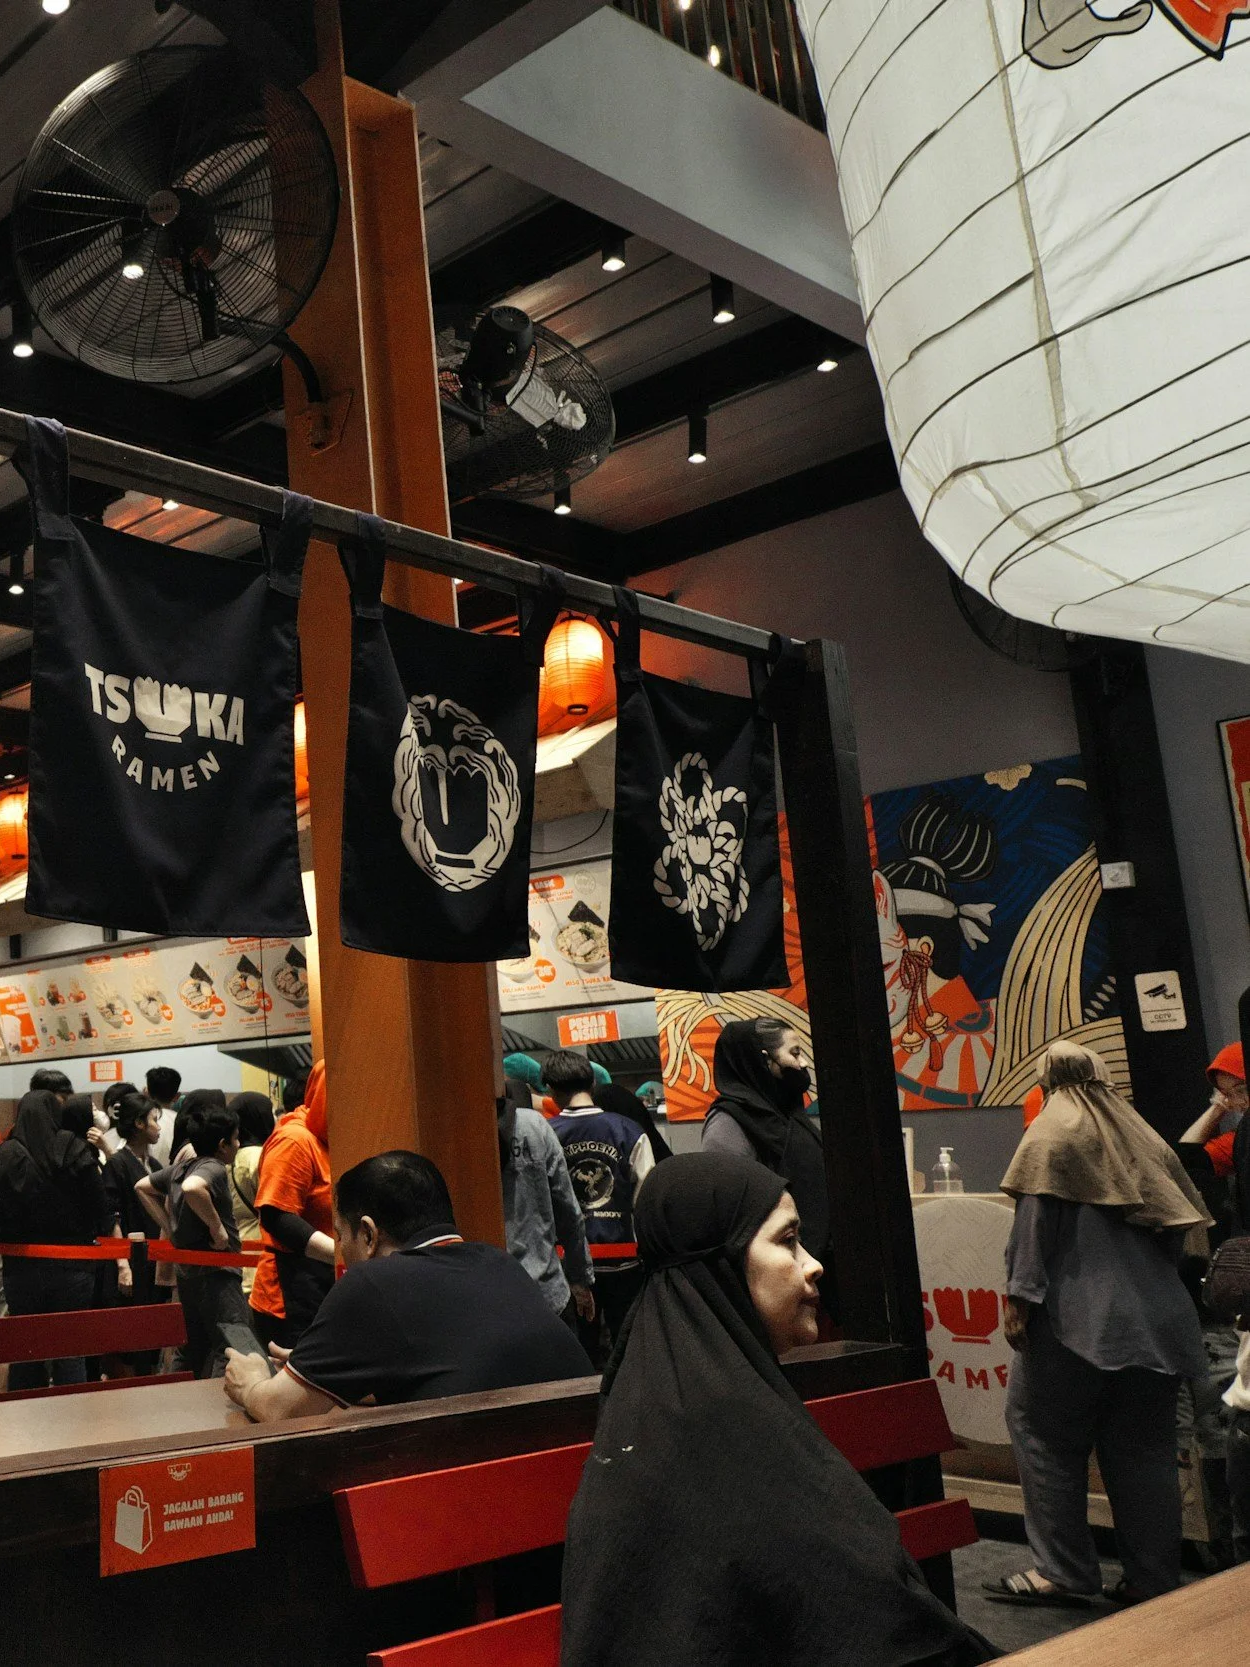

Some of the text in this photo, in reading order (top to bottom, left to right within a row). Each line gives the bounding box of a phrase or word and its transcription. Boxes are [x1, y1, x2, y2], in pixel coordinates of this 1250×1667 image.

[84, 663, 246, 746] TSUKA
[111, 734, 221, 792] RAMEN
[568, 1014, 607, 1031] PESAN
[570, 1028, 608, 1043] DISINI
[928, 1350, 1009, 1391] AME
[163, 1491, 244, 1515] JAGALAH BARANG
[163, 1510, 233, 1531] BAWAAN ANDA!
